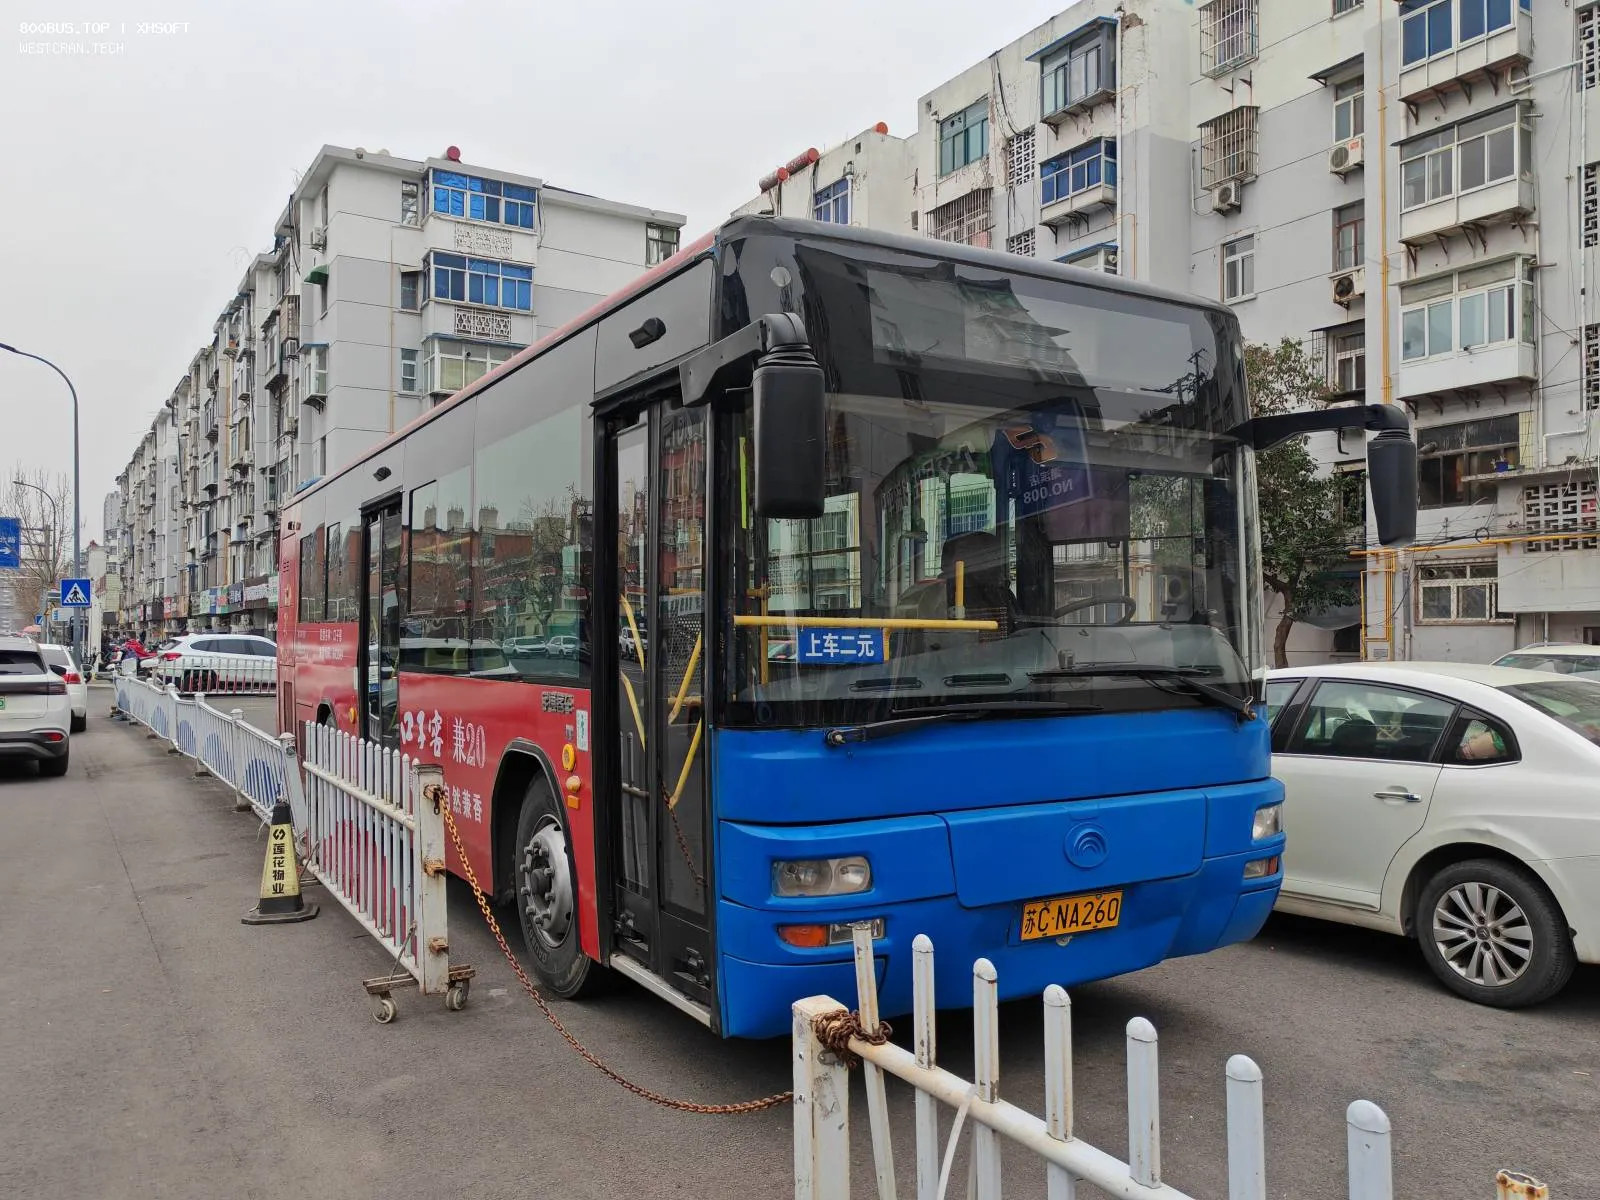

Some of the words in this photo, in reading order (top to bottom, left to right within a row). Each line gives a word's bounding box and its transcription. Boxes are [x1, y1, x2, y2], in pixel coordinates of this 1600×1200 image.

[805, 632, 875, 658] 上车二元
[452, 717, 486, 769] 兼20
[272, 843, 286, 895] 莲花物业
[1024, 897, 1120, 934] 苏C·NA260
